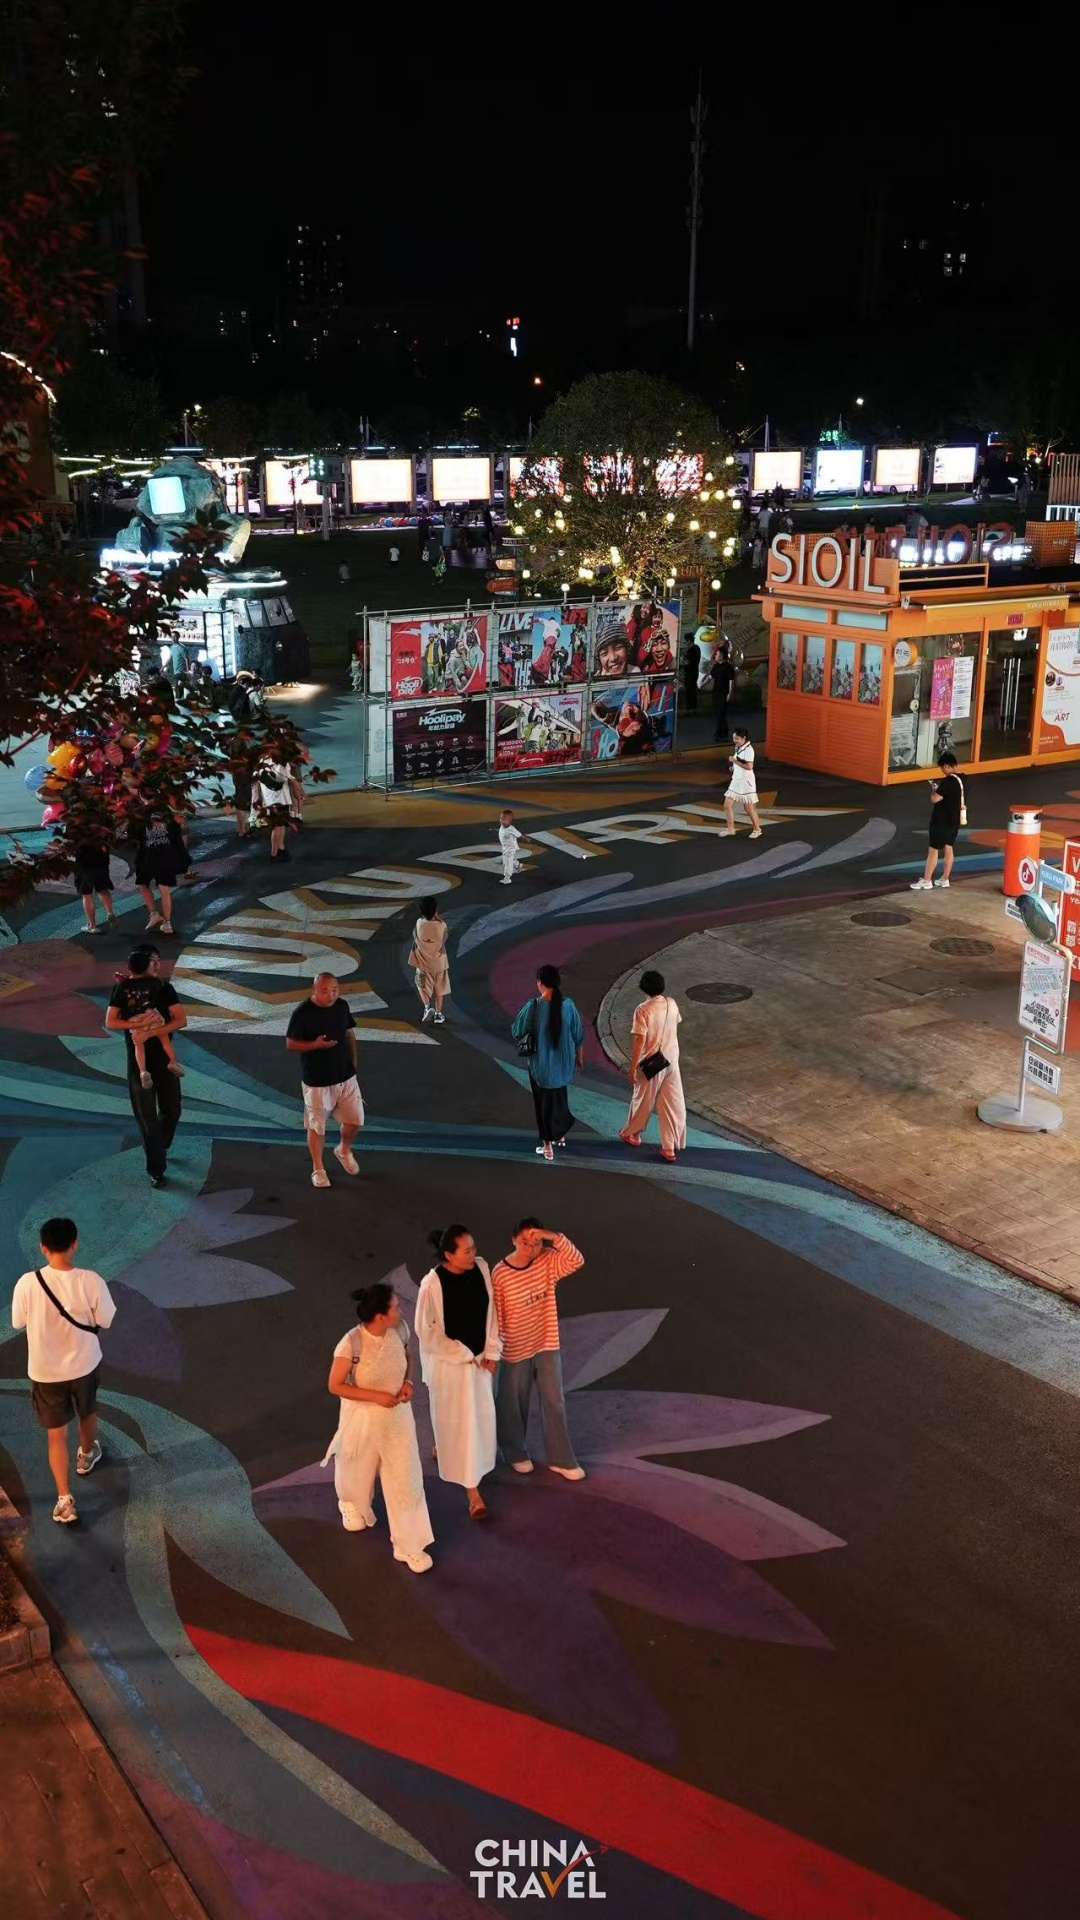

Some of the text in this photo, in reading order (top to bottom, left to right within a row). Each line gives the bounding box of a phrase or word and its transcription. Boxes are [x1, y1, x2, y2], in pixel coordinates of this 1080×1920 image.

[771, 532, 886, 594] SIOIL
[500, 612, 533, 631] LIVE
[418, 713, 466, 726] Hoolipay
